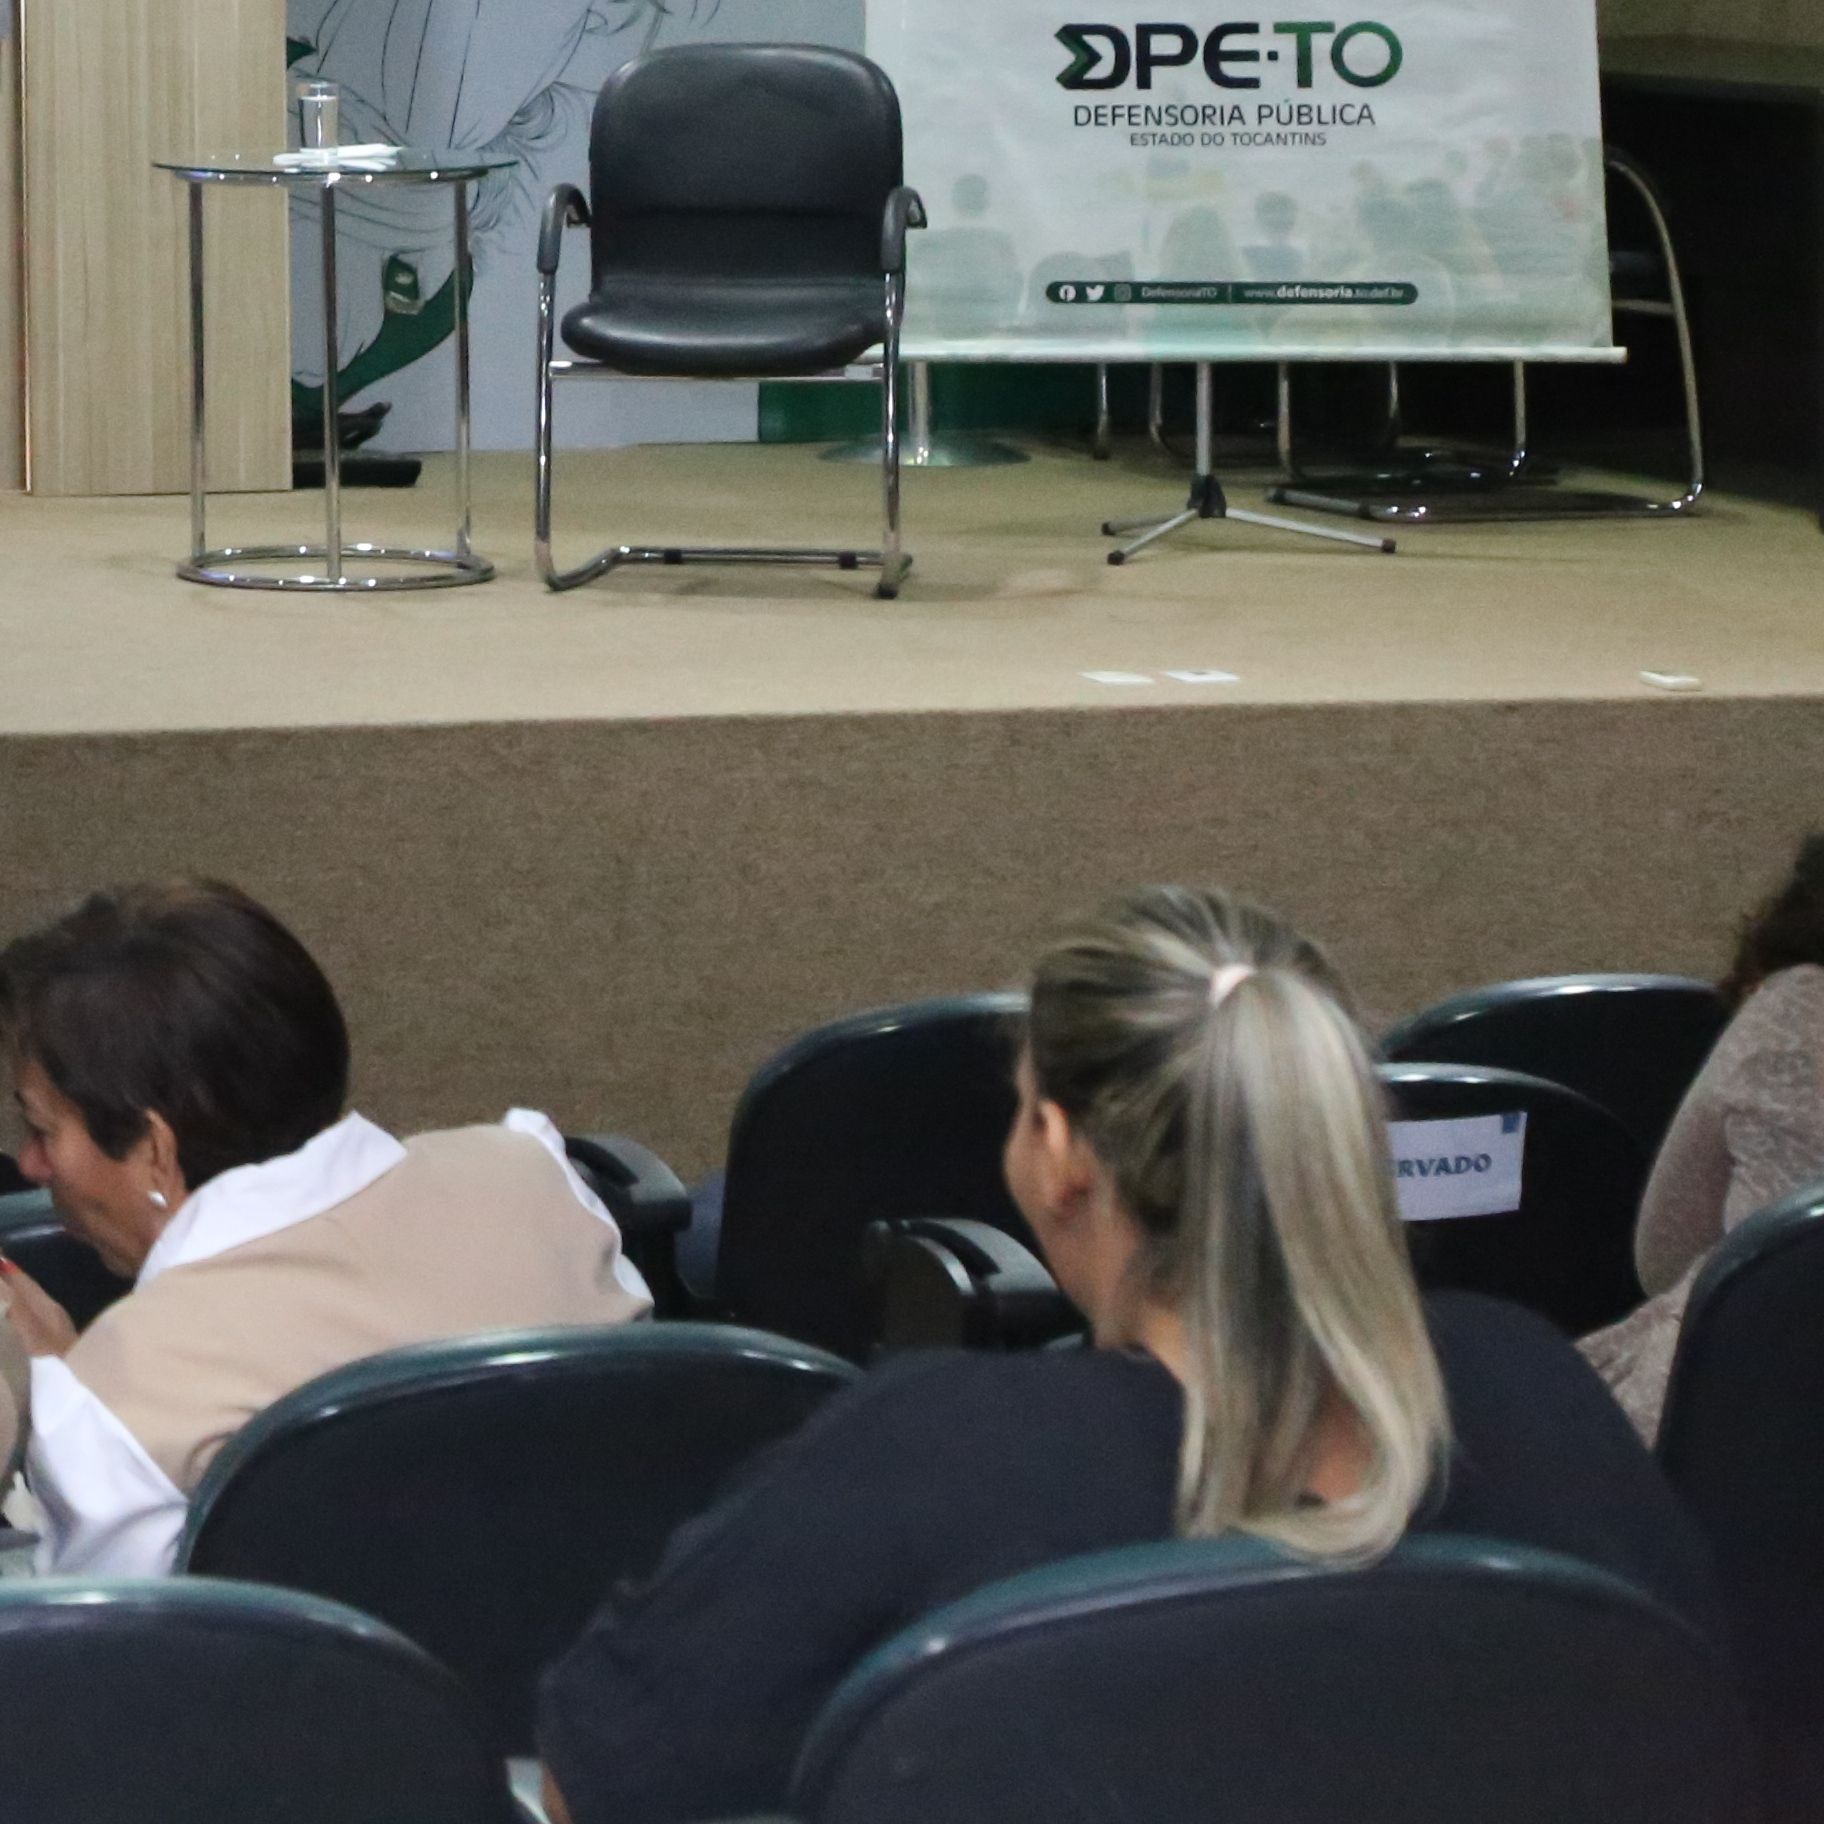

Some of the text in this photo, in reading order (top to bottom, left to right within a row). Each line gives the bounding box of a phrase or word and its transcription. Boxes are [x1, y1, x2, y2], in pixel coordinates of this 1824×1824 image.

[1073, 99, 1376, 127] DEFENSORIA PÚBLICA
[1130, 132, 1327, 147] ESTADO DO TOCANTINS
